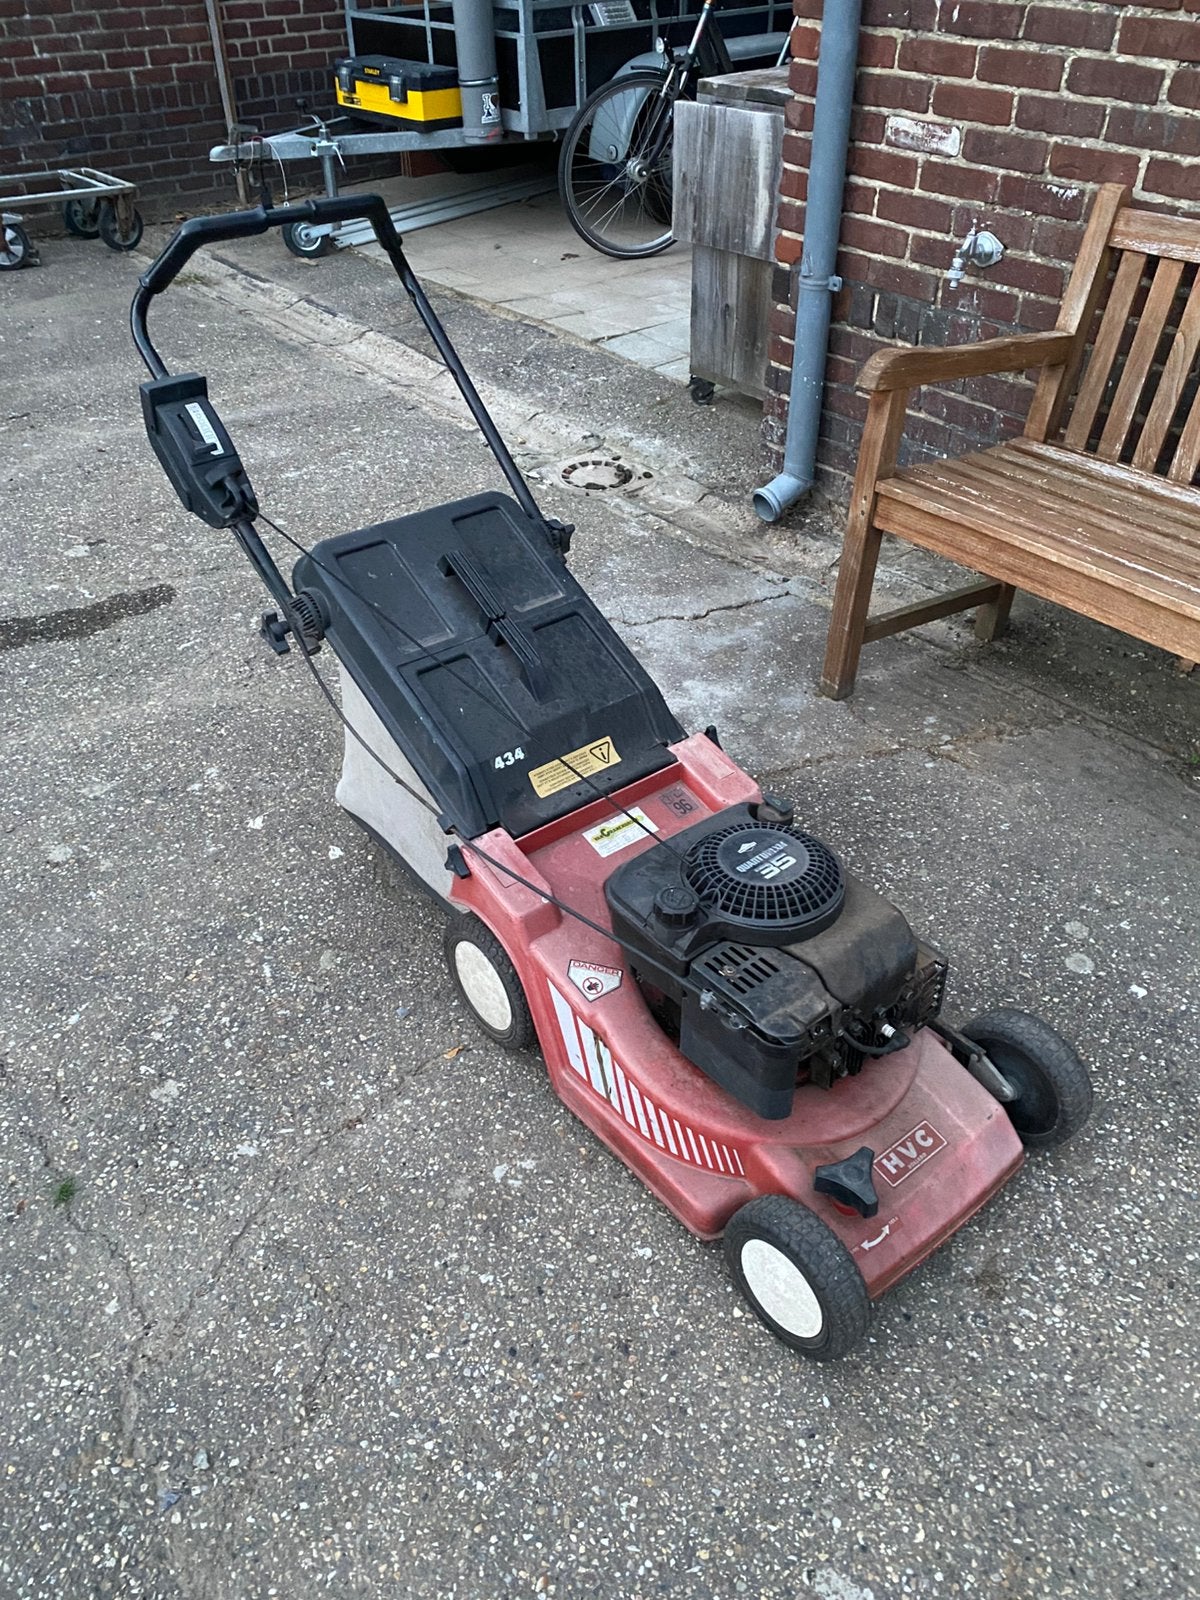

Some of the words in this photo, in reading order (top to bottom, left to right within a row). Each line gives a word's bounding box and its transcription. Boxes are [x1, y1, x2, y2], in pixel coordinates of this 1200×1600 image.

[494, 746, 525, 770] 434
[673, 799, 693, 816] 96
[736, 847, 776, 873] QUANTUM
[754, 853, 797, 879] 35
[572, 961, 620, 976] DANGER
[881, 1129, 934, 1175] HVC
